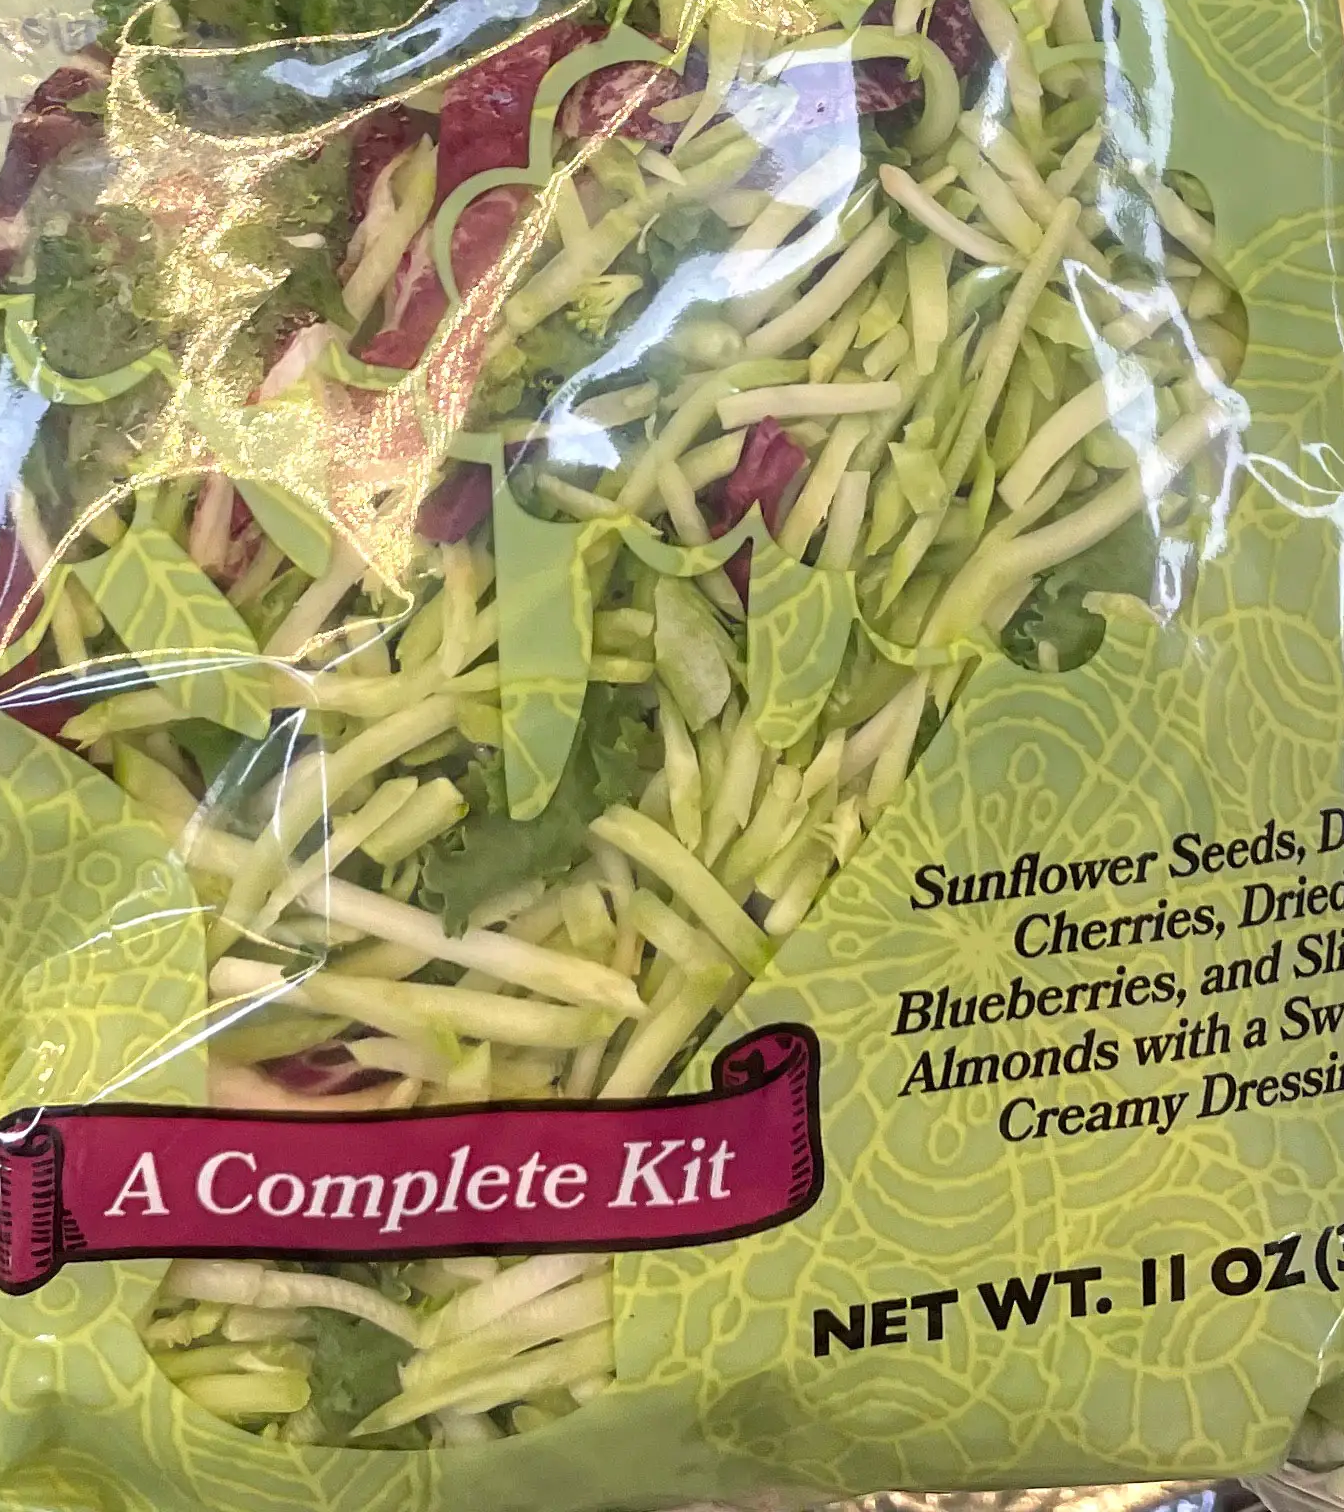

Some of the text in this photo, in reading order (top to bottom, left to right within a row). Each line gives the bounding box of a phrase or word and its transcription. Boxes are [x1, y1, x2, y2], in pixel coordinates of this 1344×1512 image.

[910, 850, 1159, 912] Sunflower
[1167, 817, 1307, 879] Seeds,
[1013, 898, 1226, 959] Cherries,
[890, 964, 1187, 1037] Blueberries,
[1200, 944, 1281, 996] and
[897, 1027, 1119, 1098] Almonds
[1132, 1011, 1230, 1068] with
[1242, 1023, 1267, 1050] a
[998, 1090, 1189, 1144] Creamy
[104, 1136, 736, 1234] A Complete Kit
[812, 1289, 959, 1358] NET
[977, 1266, 1114, 1332] WT.
[1141, 1254, 1186, 1307] 11
[1211, 1234, 1306, 1296] OZ
